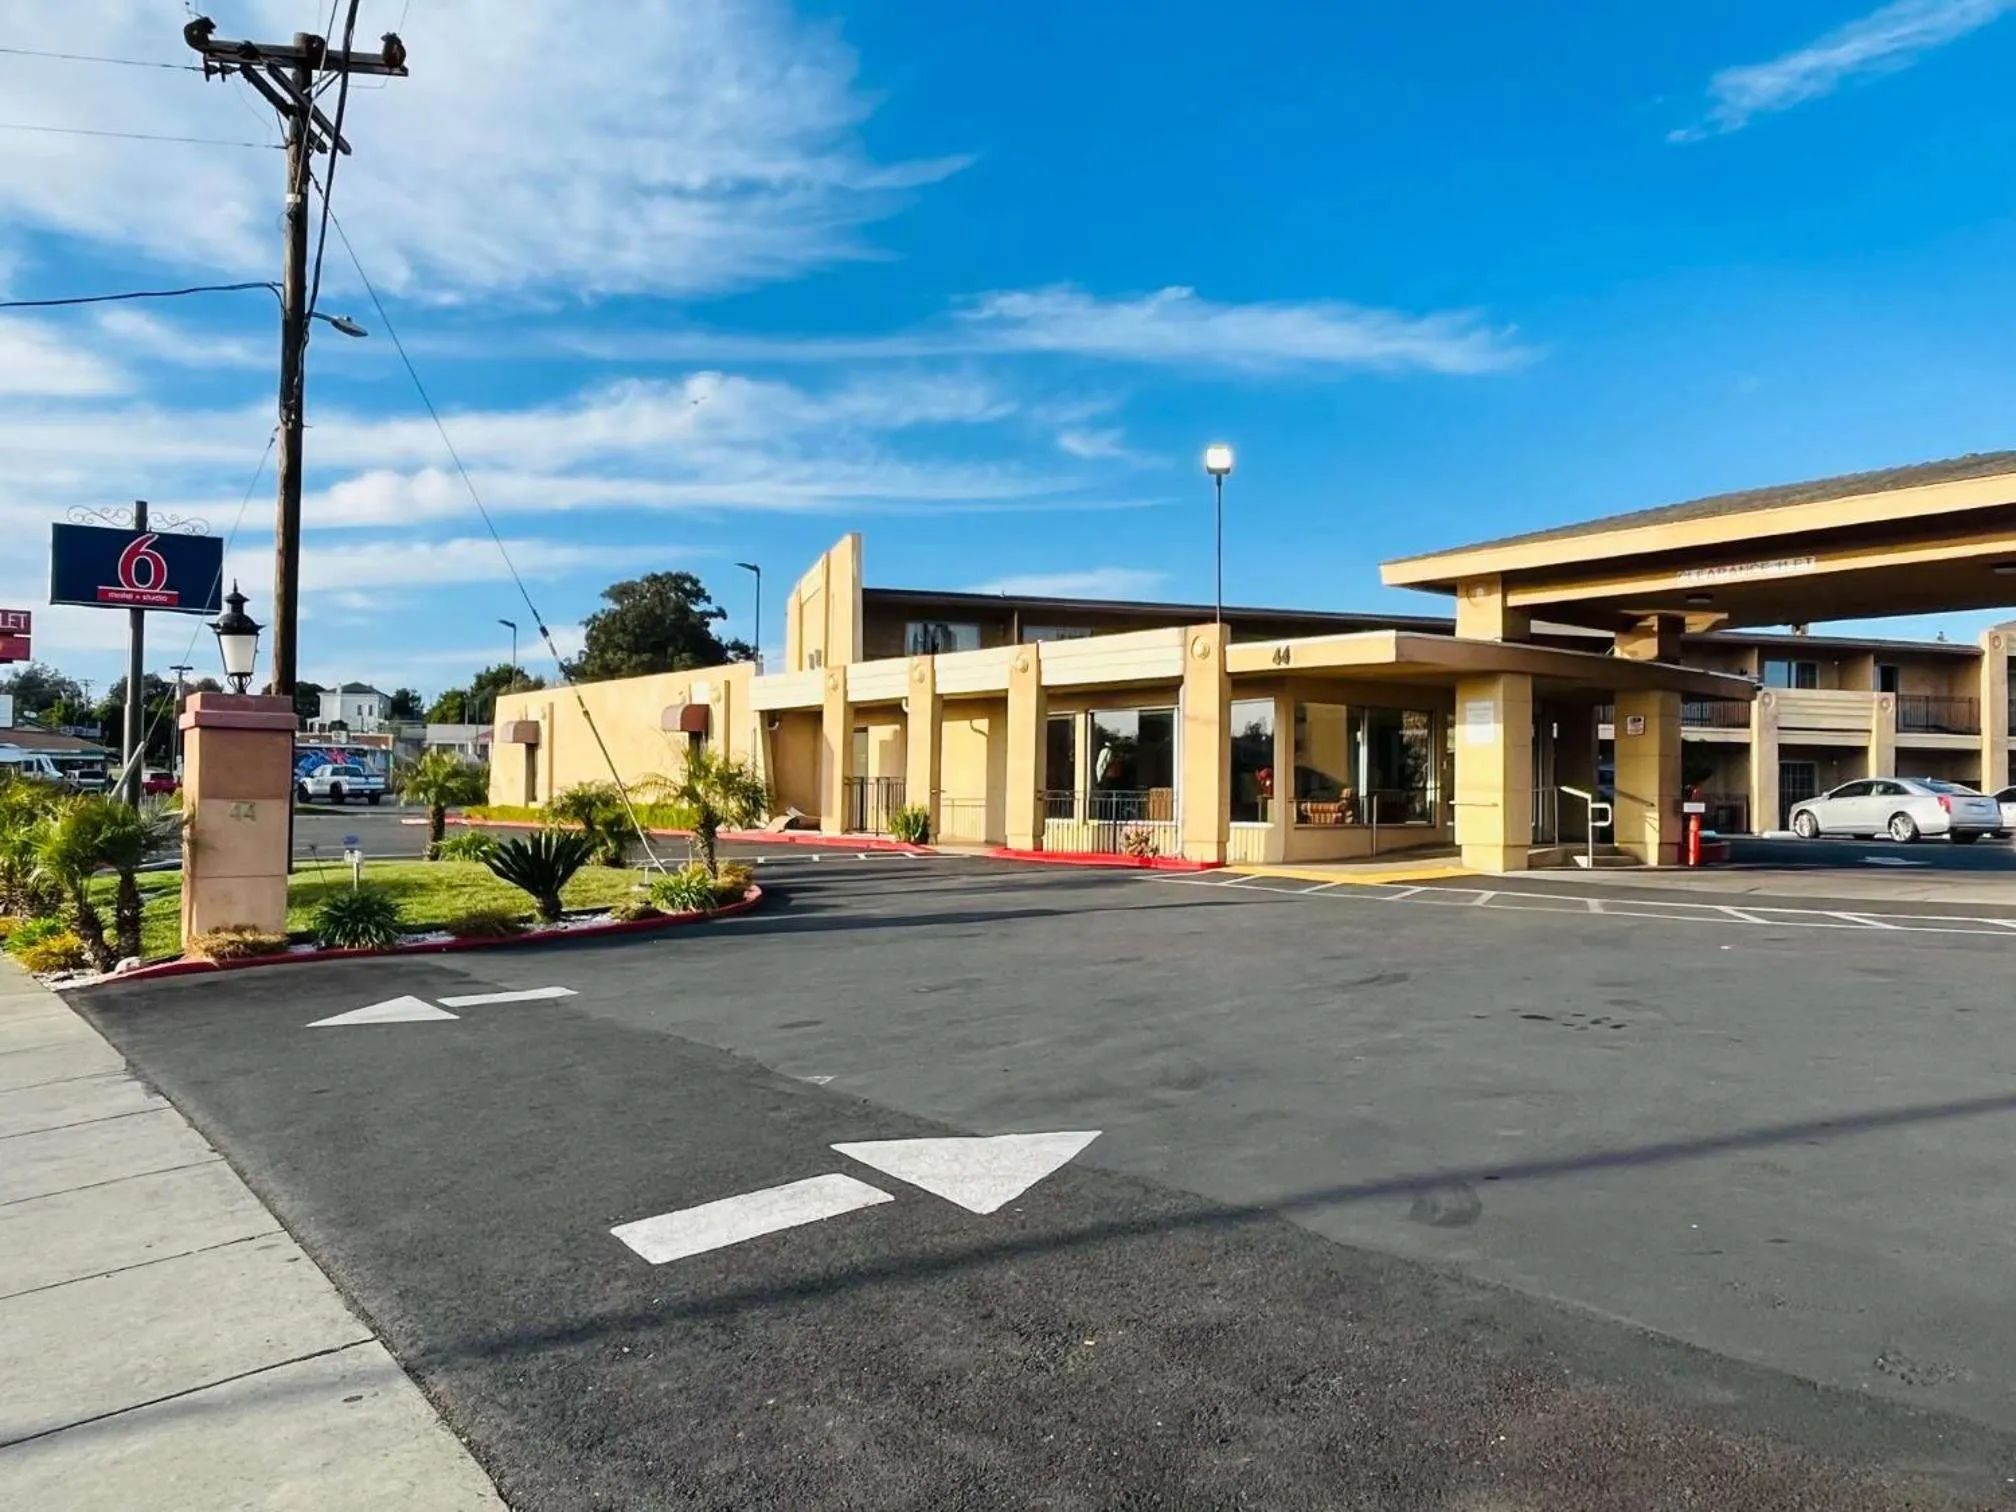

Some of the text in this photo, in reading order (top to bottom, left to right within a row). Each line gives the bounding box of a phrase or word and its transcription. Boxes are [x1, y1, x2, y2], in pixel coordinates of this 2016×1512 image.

[118, 533, 167, 592] 6
[1272, 645, 1291, 666] 44
[229, 800, 257, 822] 44
